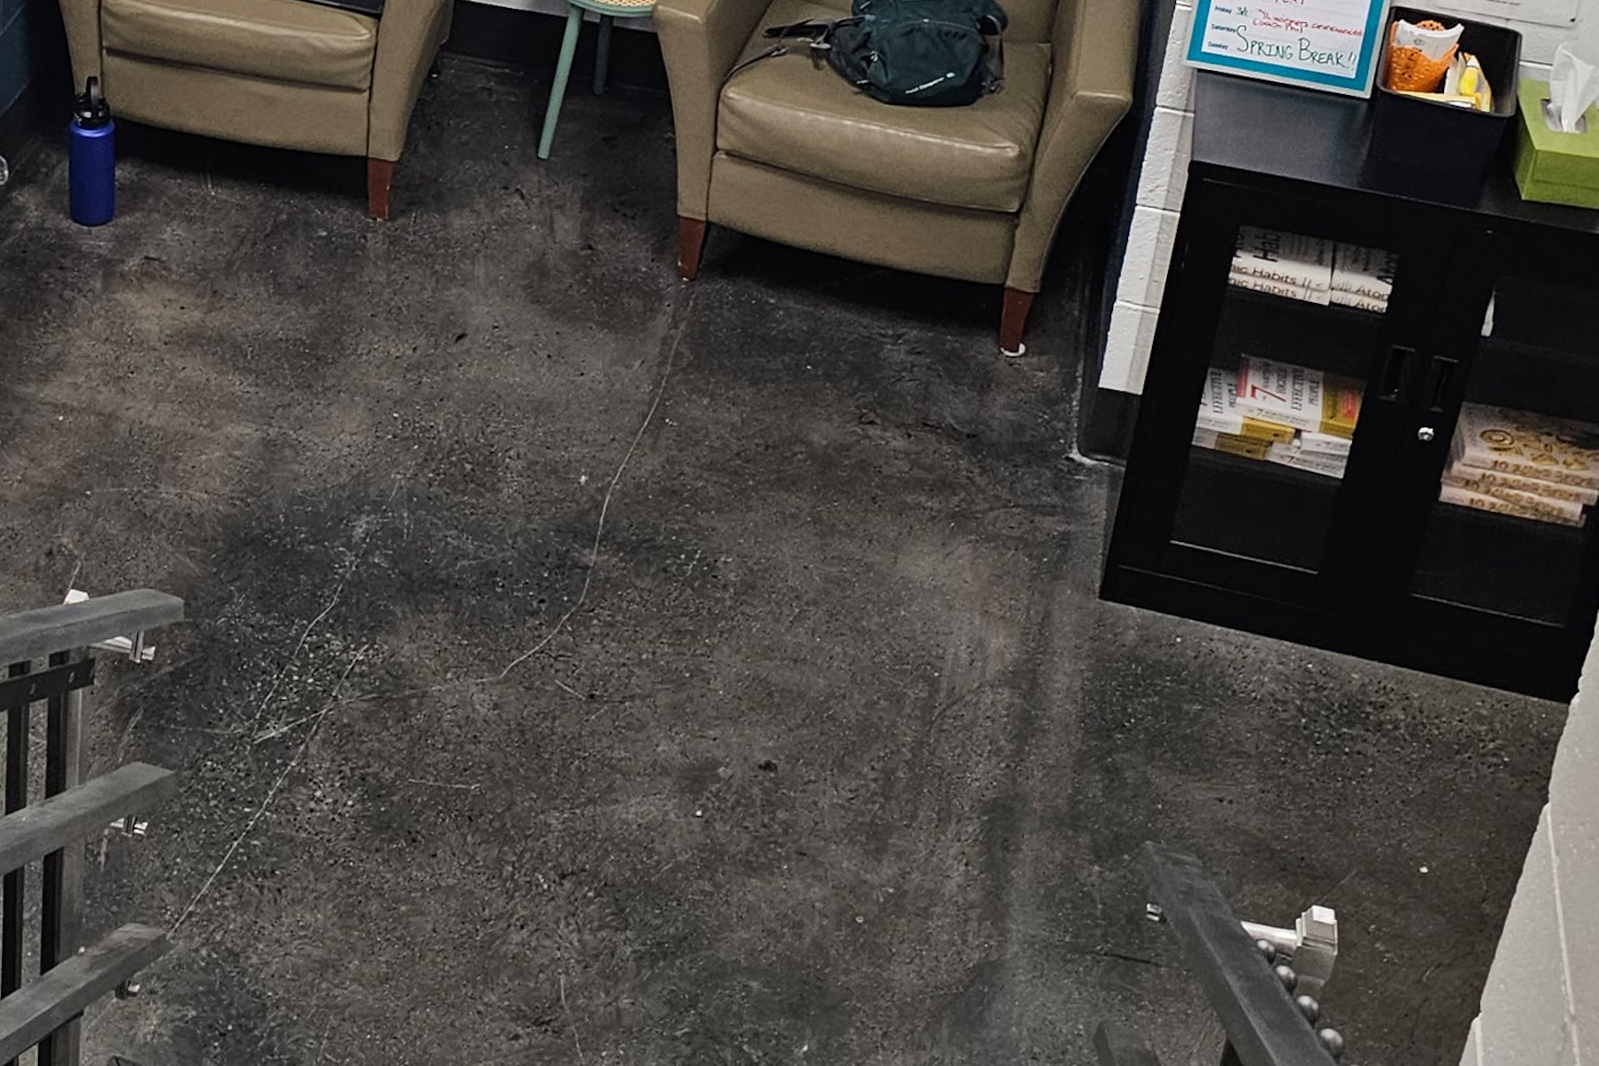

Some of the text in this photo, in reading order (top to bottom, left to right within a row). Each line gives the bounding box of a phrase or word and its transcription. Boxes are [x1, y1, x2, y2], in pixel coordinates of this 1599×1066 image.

[1236, 25, 1294, 61] SPRING
[1252, 268, 1298, 285] Habits
[1252, 280, 1298, 298] Habits
[1250, 384, 1287, 403] 7
